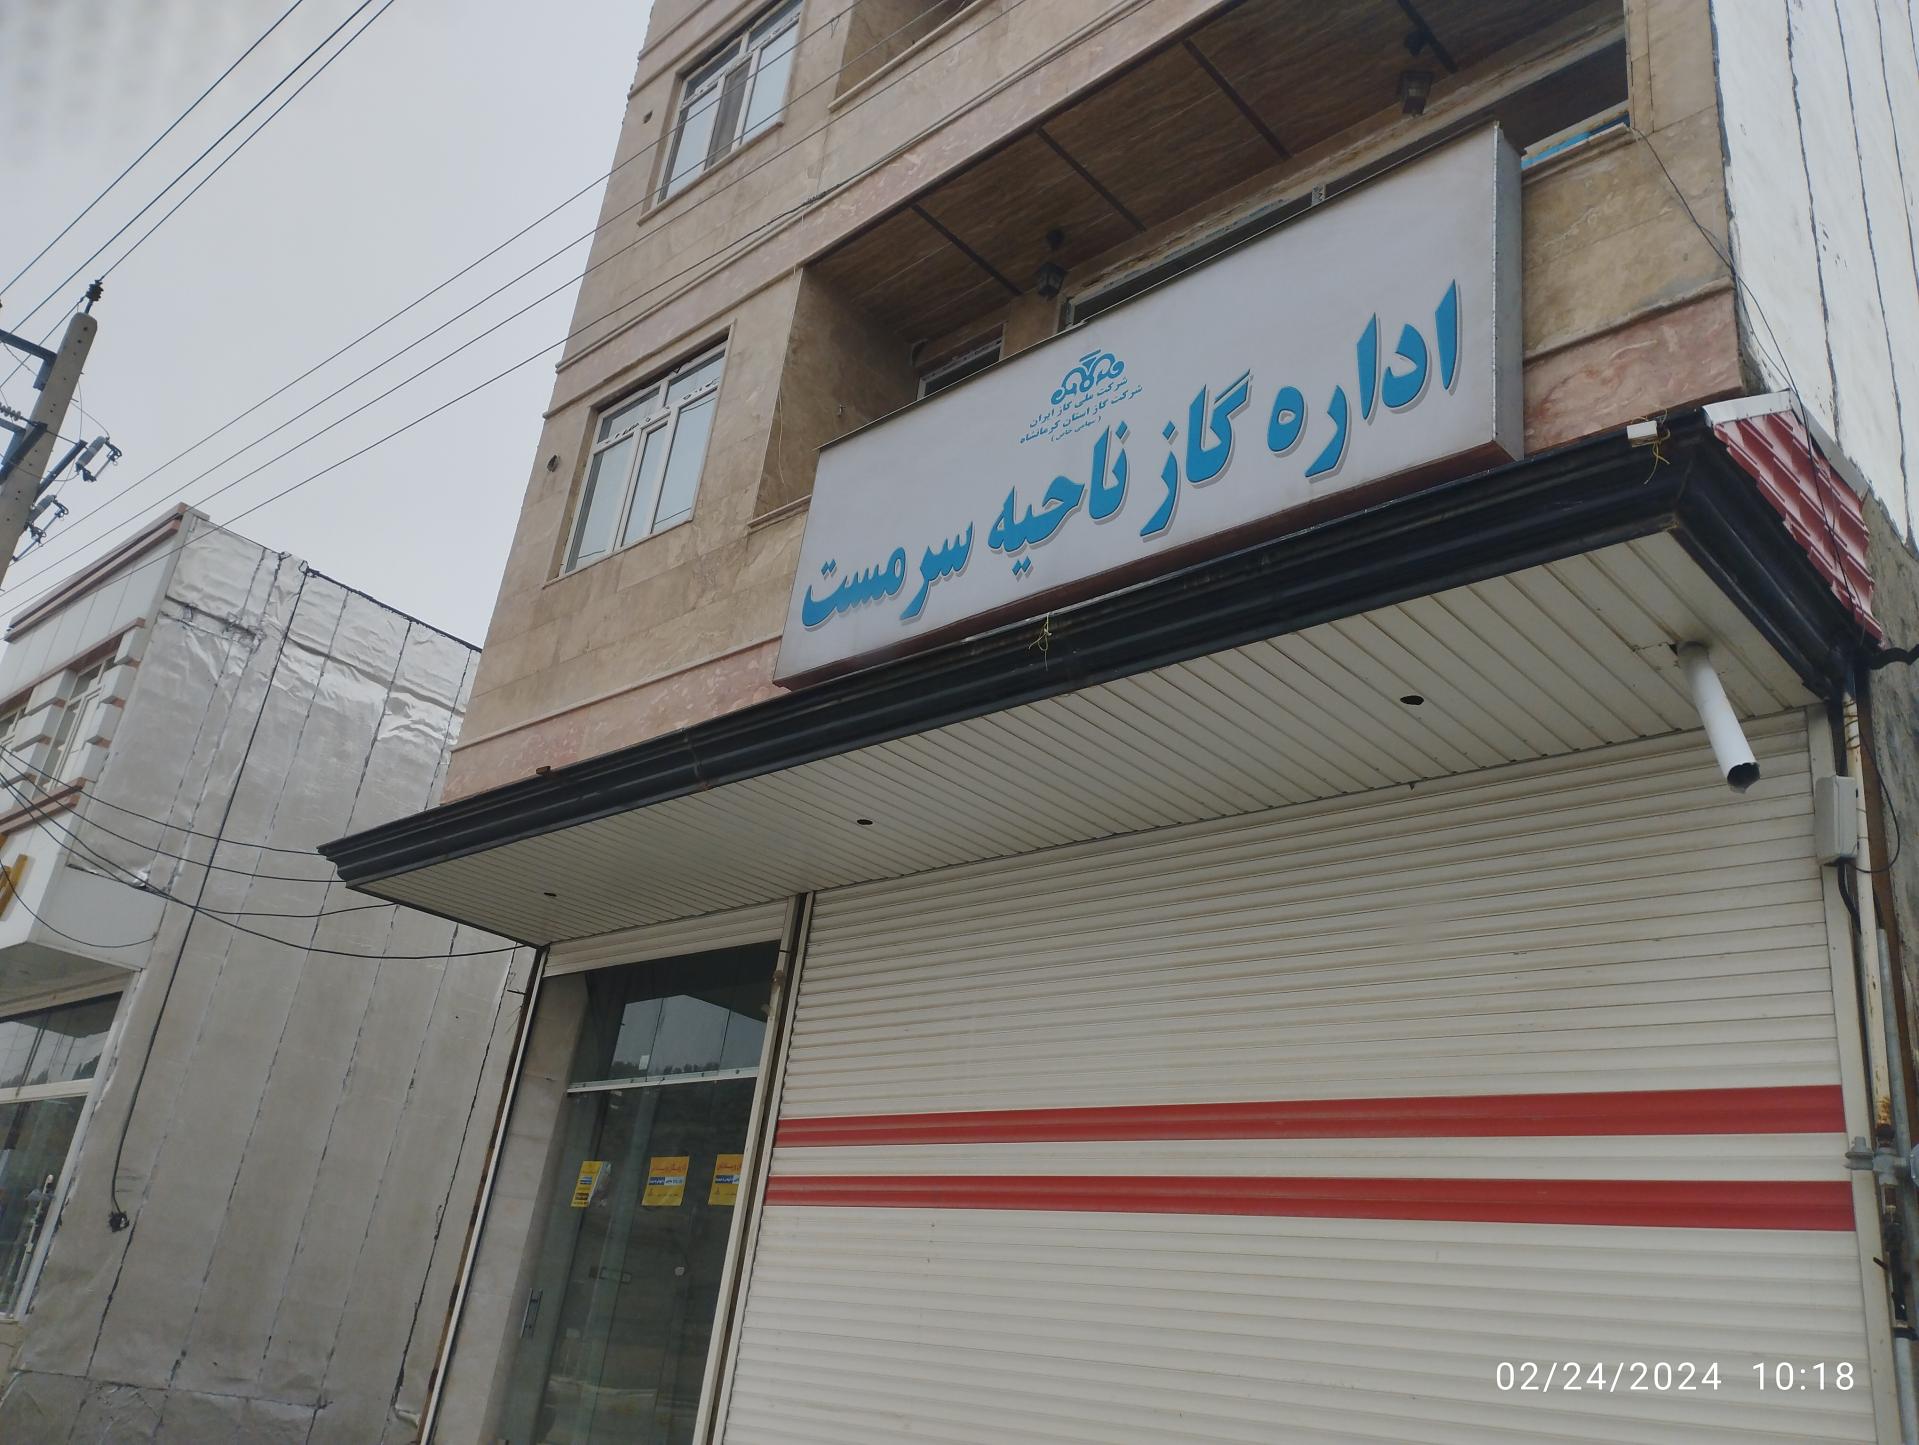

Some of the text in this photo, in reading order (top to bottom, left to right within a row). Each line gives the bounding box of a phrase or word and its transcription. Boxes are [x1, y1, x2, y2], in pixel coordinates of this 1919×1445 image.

[1097, 377, 1128, 396] شرکت
[1110, 384, 1143, 404] شرکت
[1074, 393, 1094, 408] ملی
[1029, 408, 1055, 428] ایران
[1062, 407, 1090, 428] استان
[1019, 419, 1061, 444] کرمانشاه
[801, 280, 1459, 628] اداره گاز ناحیه سرمست
